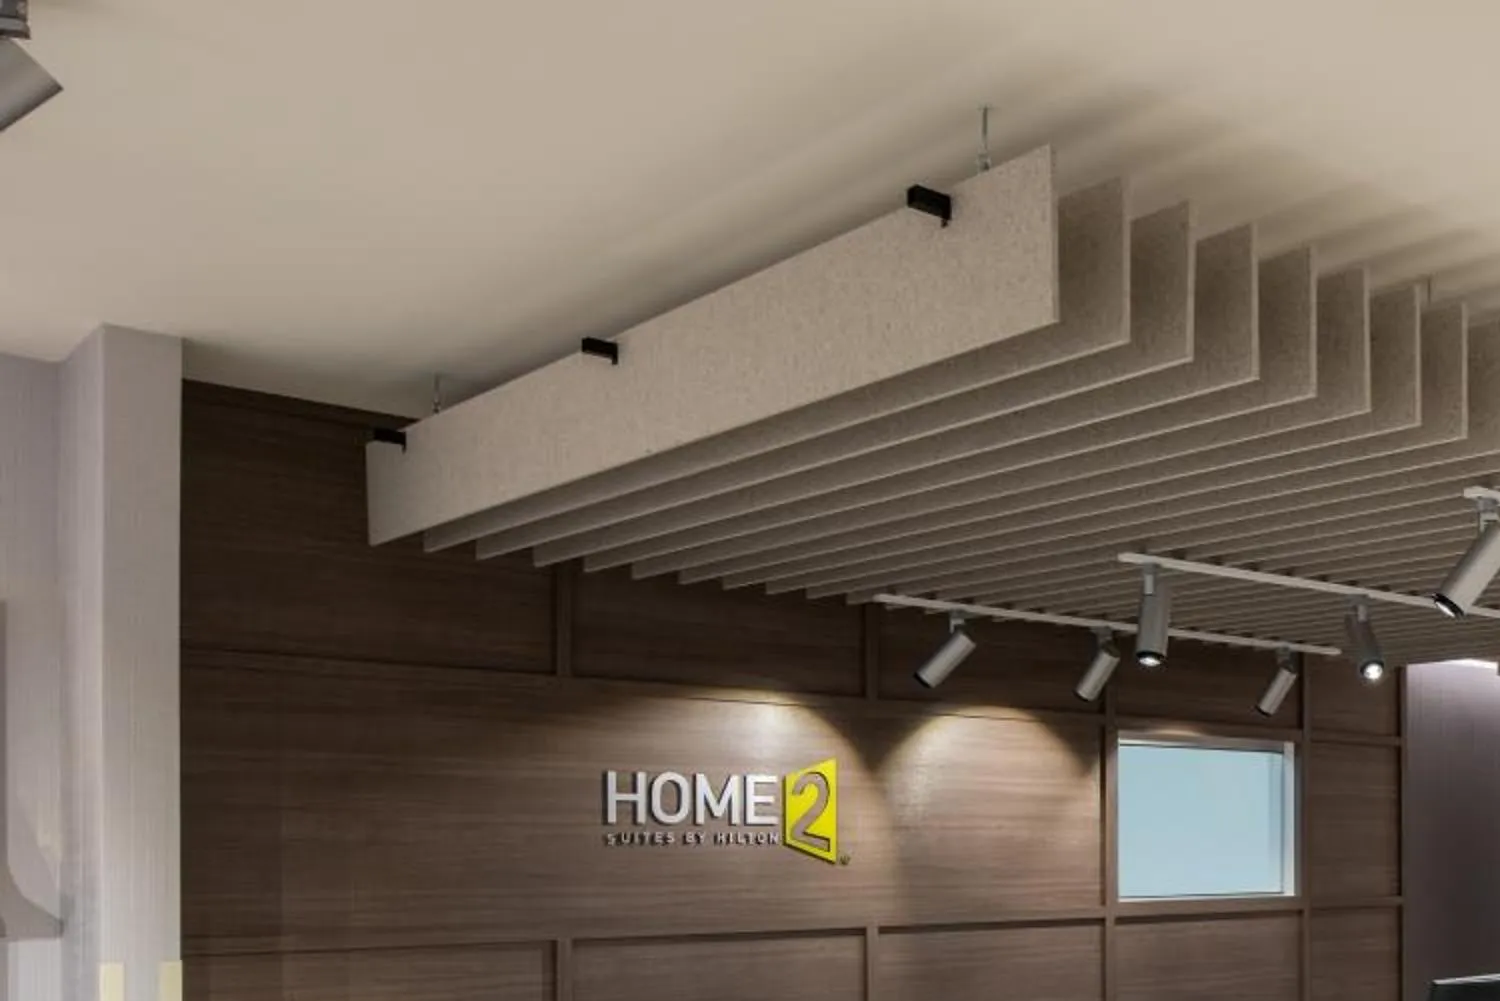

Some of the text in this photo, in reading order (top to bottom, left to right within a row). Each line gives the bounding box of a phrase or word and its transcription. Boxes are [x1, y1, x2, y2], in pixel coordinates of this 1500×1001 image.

[605, 770, 779, 826] HOME
[606, 831, 779, 847] SUITES BY HILTON
